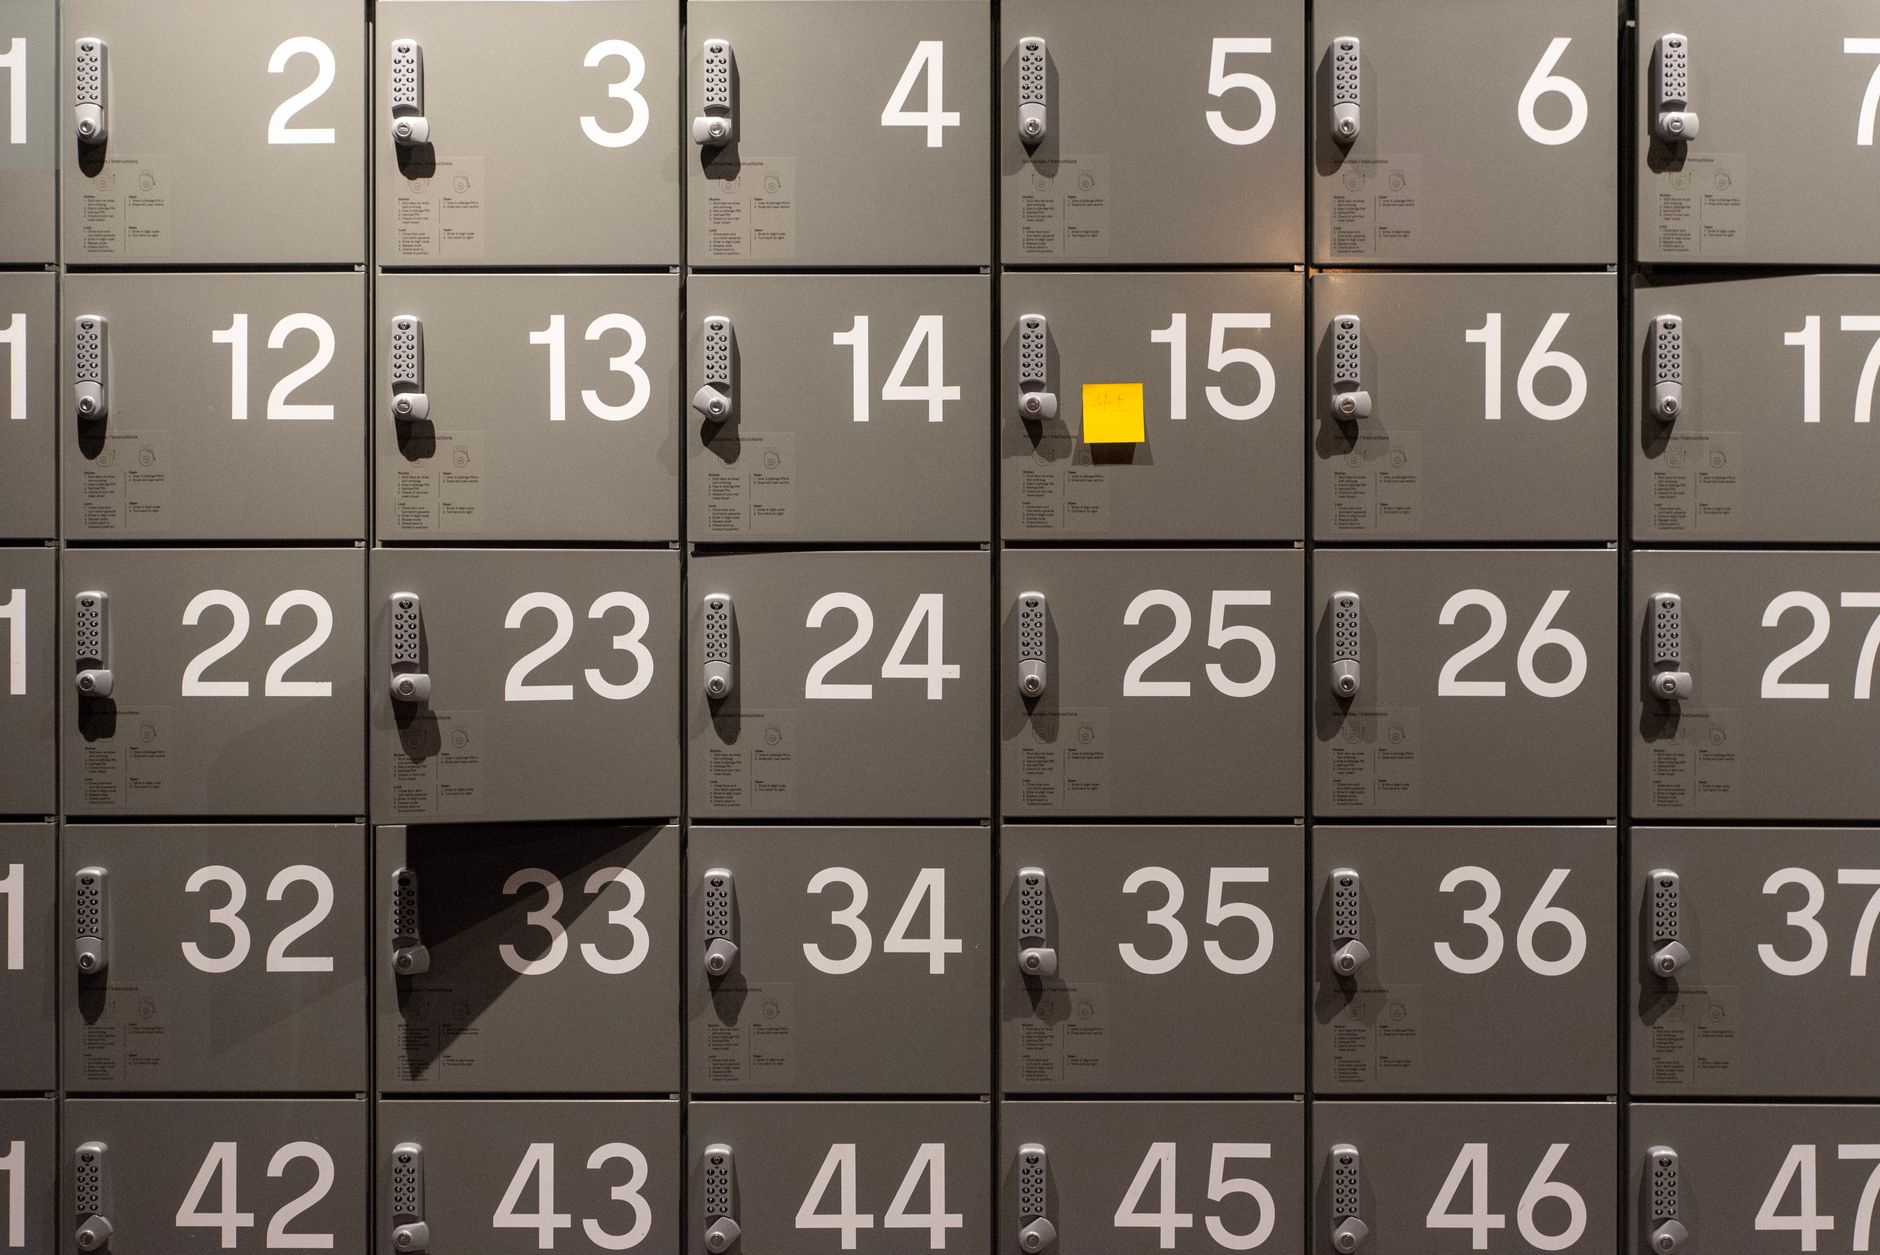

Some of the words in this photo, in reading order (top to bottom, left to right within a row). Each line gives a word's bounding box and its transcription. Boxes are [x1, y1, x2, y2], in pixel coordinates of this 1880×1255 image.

[267, 36, 336, 145] 2
[579, 39, 650, 148] 3
[881, 39, 961, 148] 4
[1205, 37, 1277, 146] 5
[1517, 37, 1589, 146] 6
[212, 312, 336, 421] 12
[529, 314, 651, 422] 13
[832, 314, 961, 423] 14
[1150, 312, 1276, 421] 15
[1465, 312, 1588, 421] 16
[181, 589, 334, 697] 22
[504, 591, 654, 702] 23
[804, 591, 961, 700] 24
[1122, 588, 1276, 698] 25
[1437, 588, 1588, 698] 26
[181, 864, 335, 975] 32
[497, 867, 650, 975] 33
[802, 866, 963, 975] 34
[1118, 866, 1274, 975] 35
[1433, 865, 1588, 977] 36
[175, 1141, 335, 1249] 42
[492, 1142, 652, 1251] 43
[795, 1142, 964, 1250] 44
[1113, 1141, 1276, 1251] 45
[1425, 1142, 1588, 1251] 46
